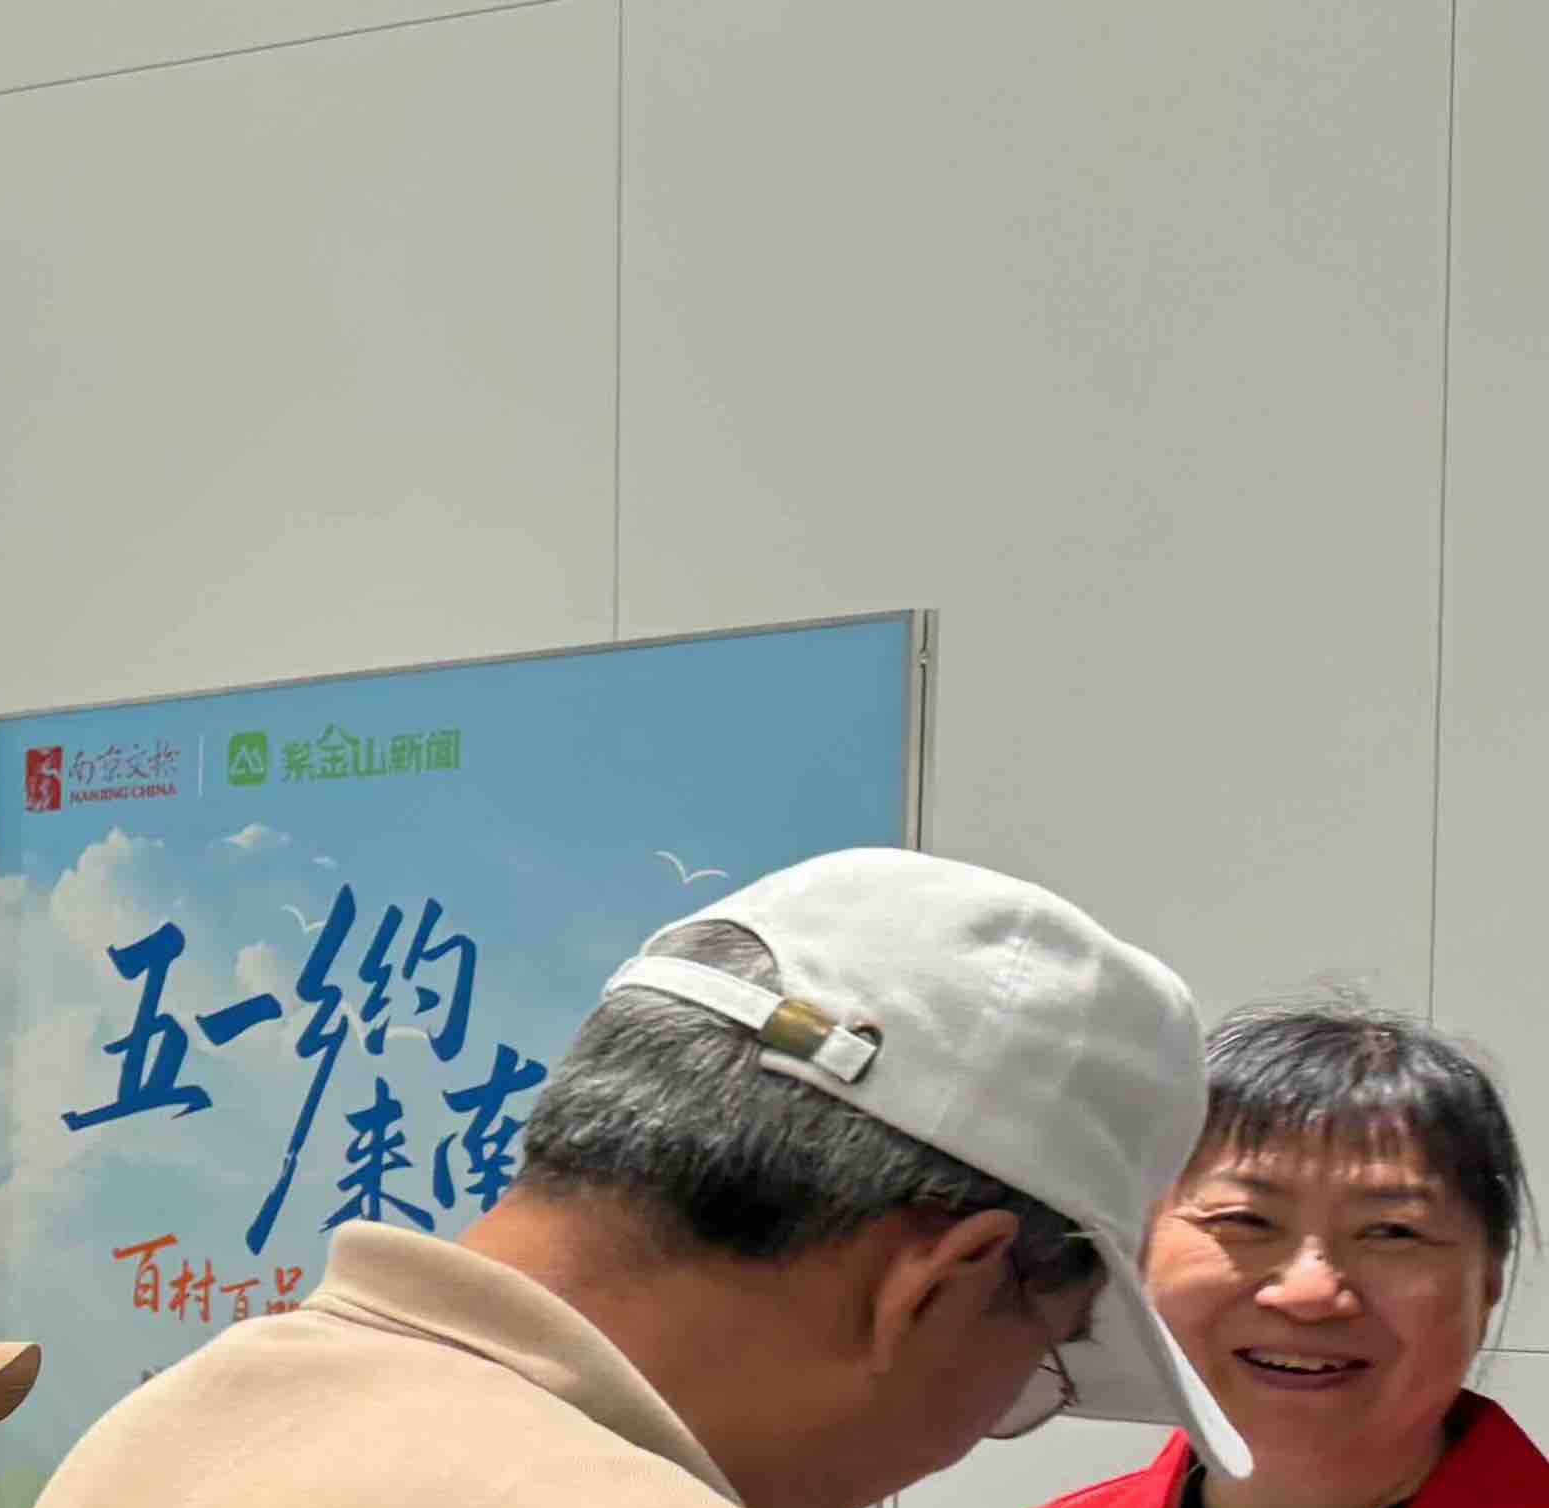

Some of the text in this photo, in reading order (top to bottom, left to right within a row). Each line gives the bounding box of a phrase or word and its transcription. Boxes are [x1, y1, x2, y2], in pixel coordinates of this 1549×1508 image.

[282, 724, 461, 783] 紫金山新闻
